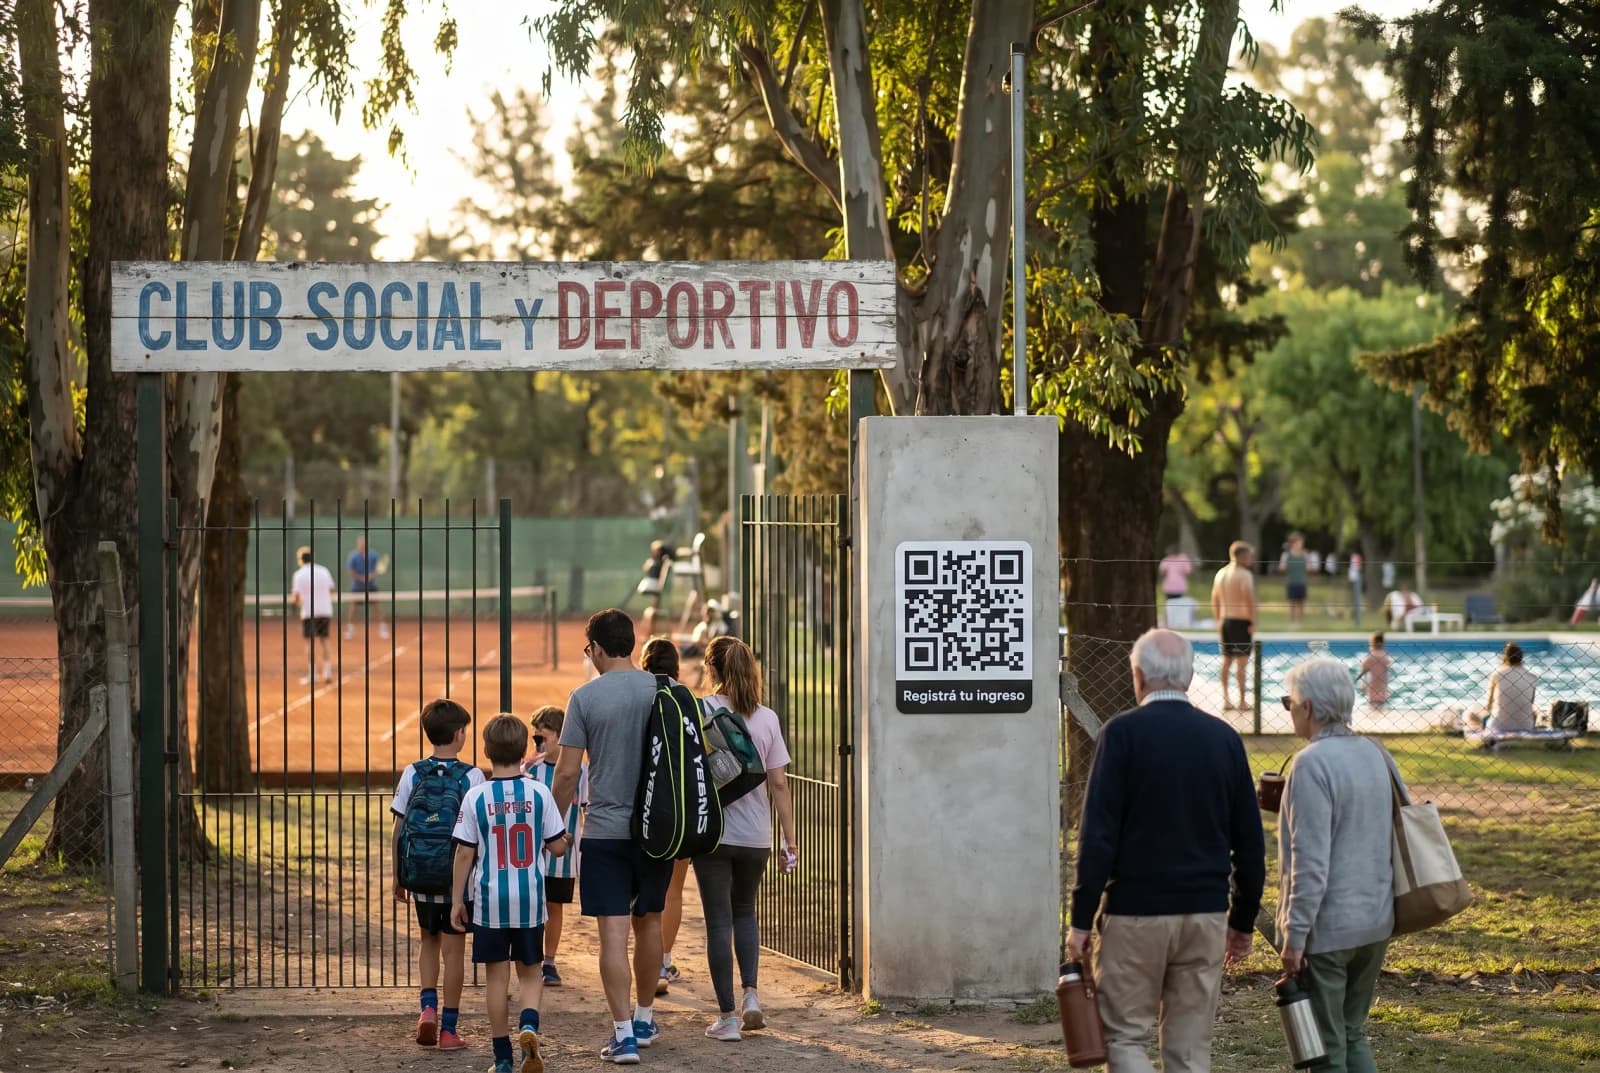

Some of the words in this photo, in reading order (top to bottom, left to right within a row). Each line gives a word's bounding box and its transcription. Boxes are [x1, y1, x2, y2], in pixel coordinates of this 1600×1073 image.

[138, 281, 283, 351] CLUB
[306, 281, 501, 351] SOCIAL
[514, 298, 544, 350] Y
[557, 279, 860, 350] DEPORTIVO
[903, 689, 957, 704] Registrá
[960, 690, 973, 701] tu
[976, 689, 1025, 704] ingreso
[491, 823, 534, 870] 10
